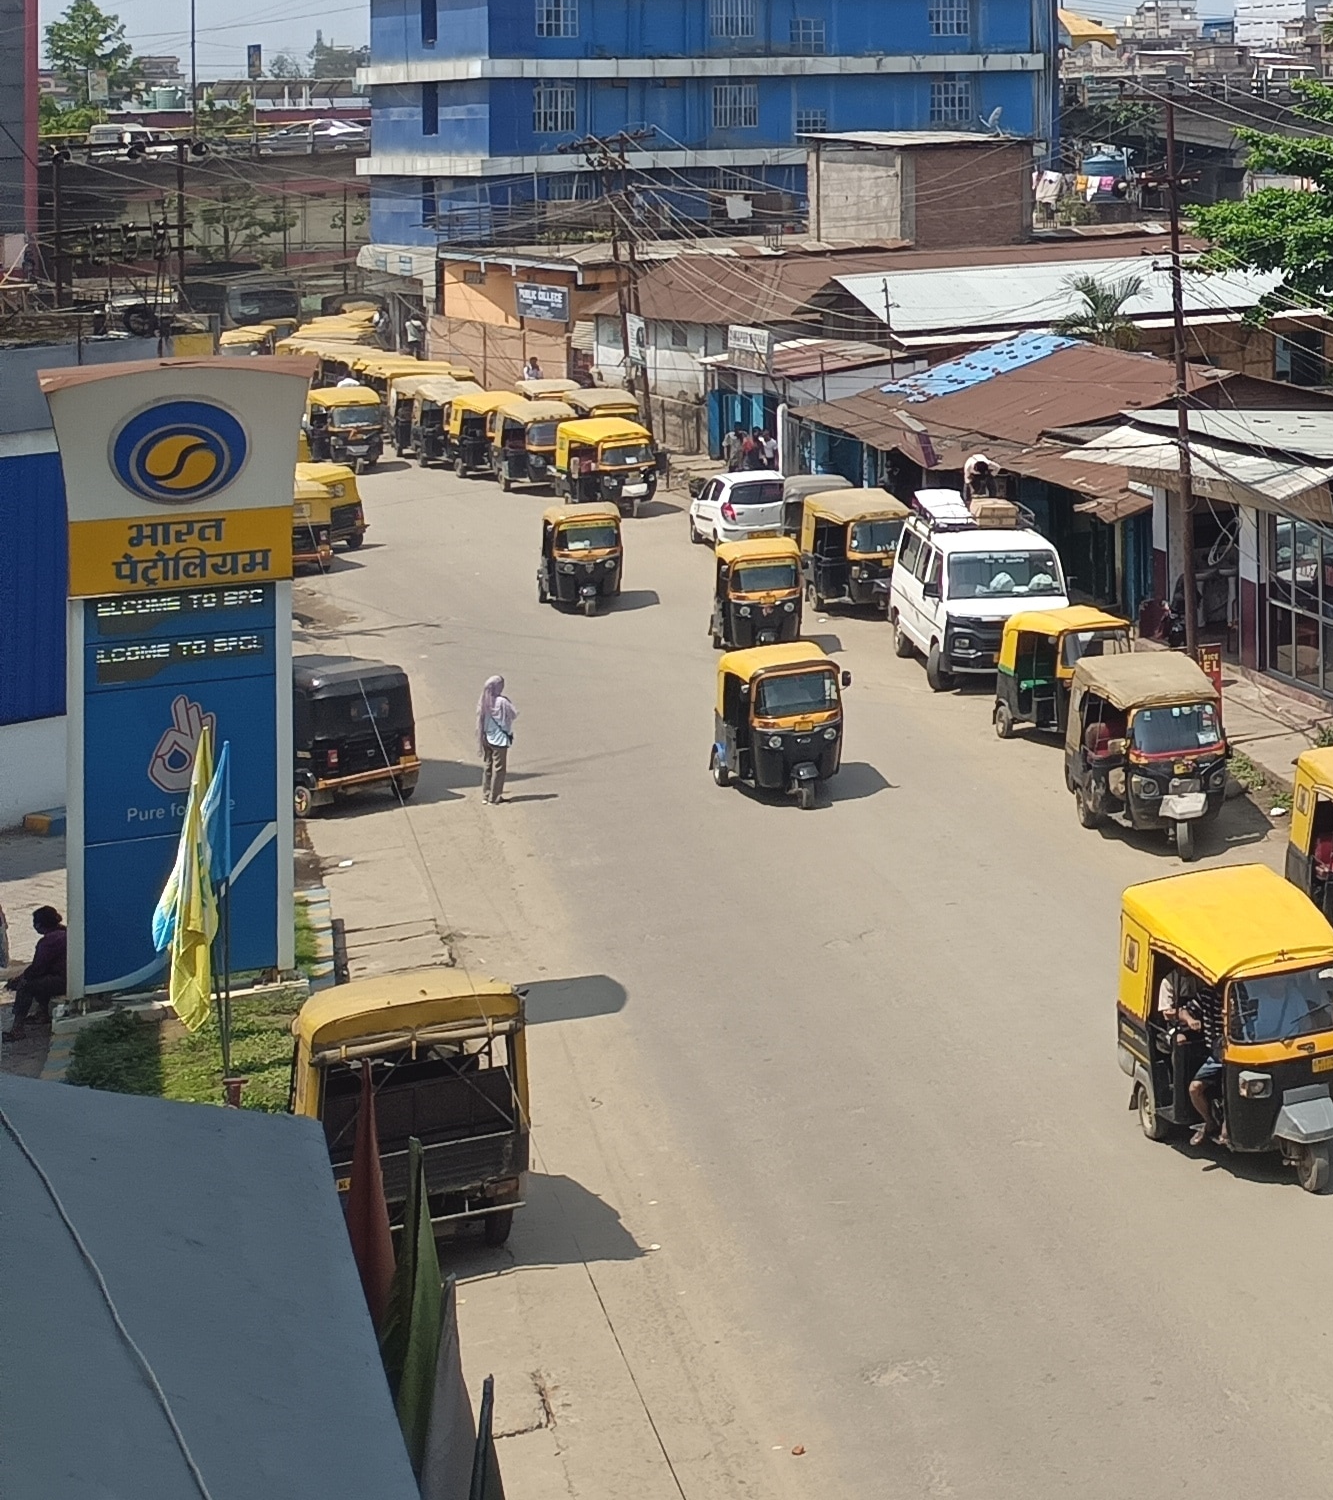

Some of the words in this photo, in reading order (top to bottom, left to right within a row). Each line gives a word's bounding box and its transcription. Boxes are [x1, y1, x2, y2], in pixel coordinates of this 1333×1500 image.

[127, 518, 226, 548] भारत
[111, 547, 272, 586] पेट्रोलियम
[188, 593, 217, 609] TO
[177, 640, 207, 656] TO
[127, 807, 166, 822] Pure
